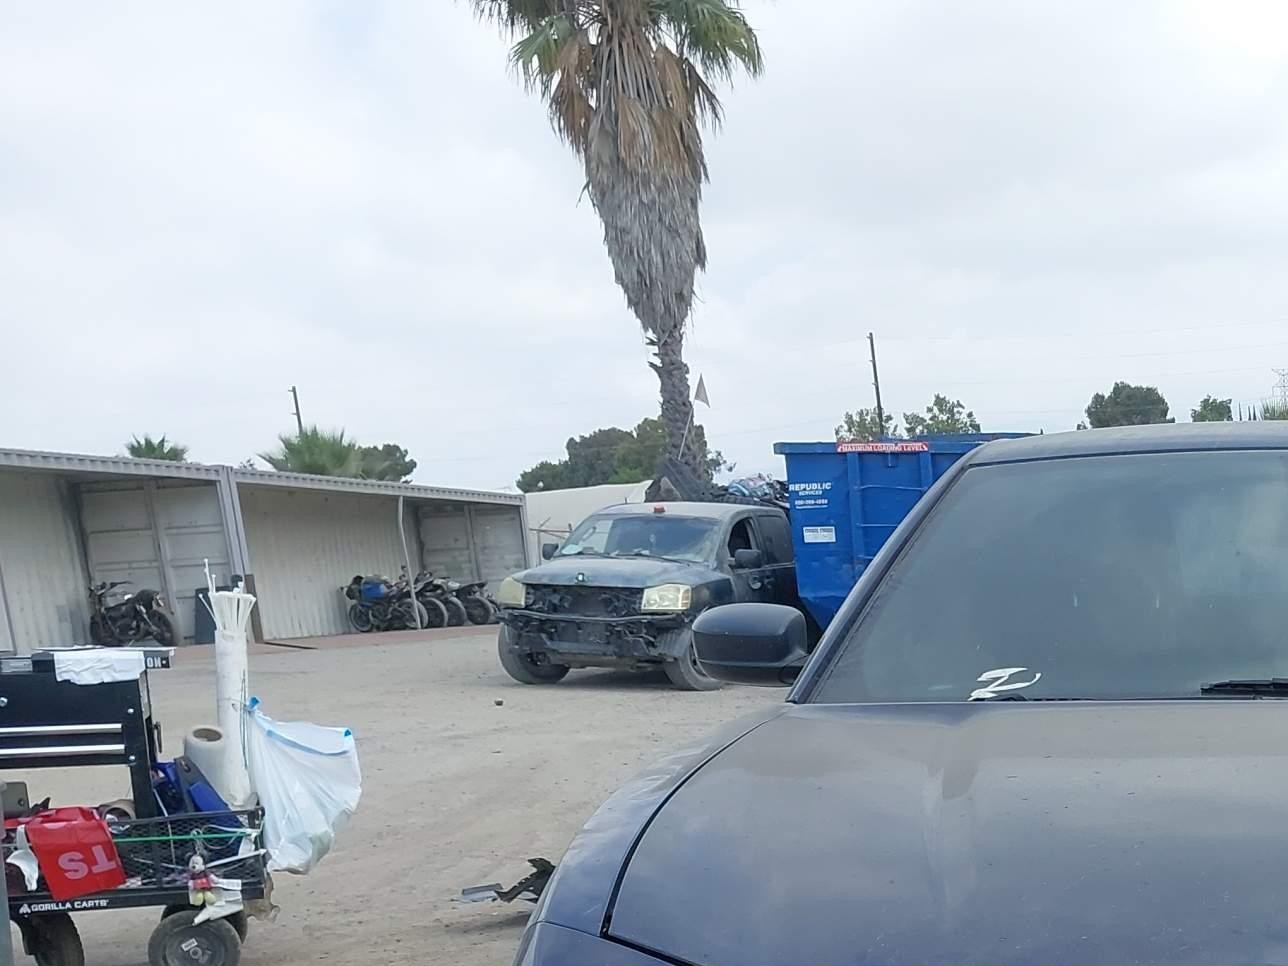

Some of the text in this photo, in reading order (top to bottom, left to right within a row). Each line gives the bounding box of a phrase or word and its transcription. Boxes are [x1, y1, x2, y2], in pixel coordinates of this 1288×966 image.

[789, 482, 832, 491] REPUBLIC
[31, 899, 107, 912] GORILLA CARTS
